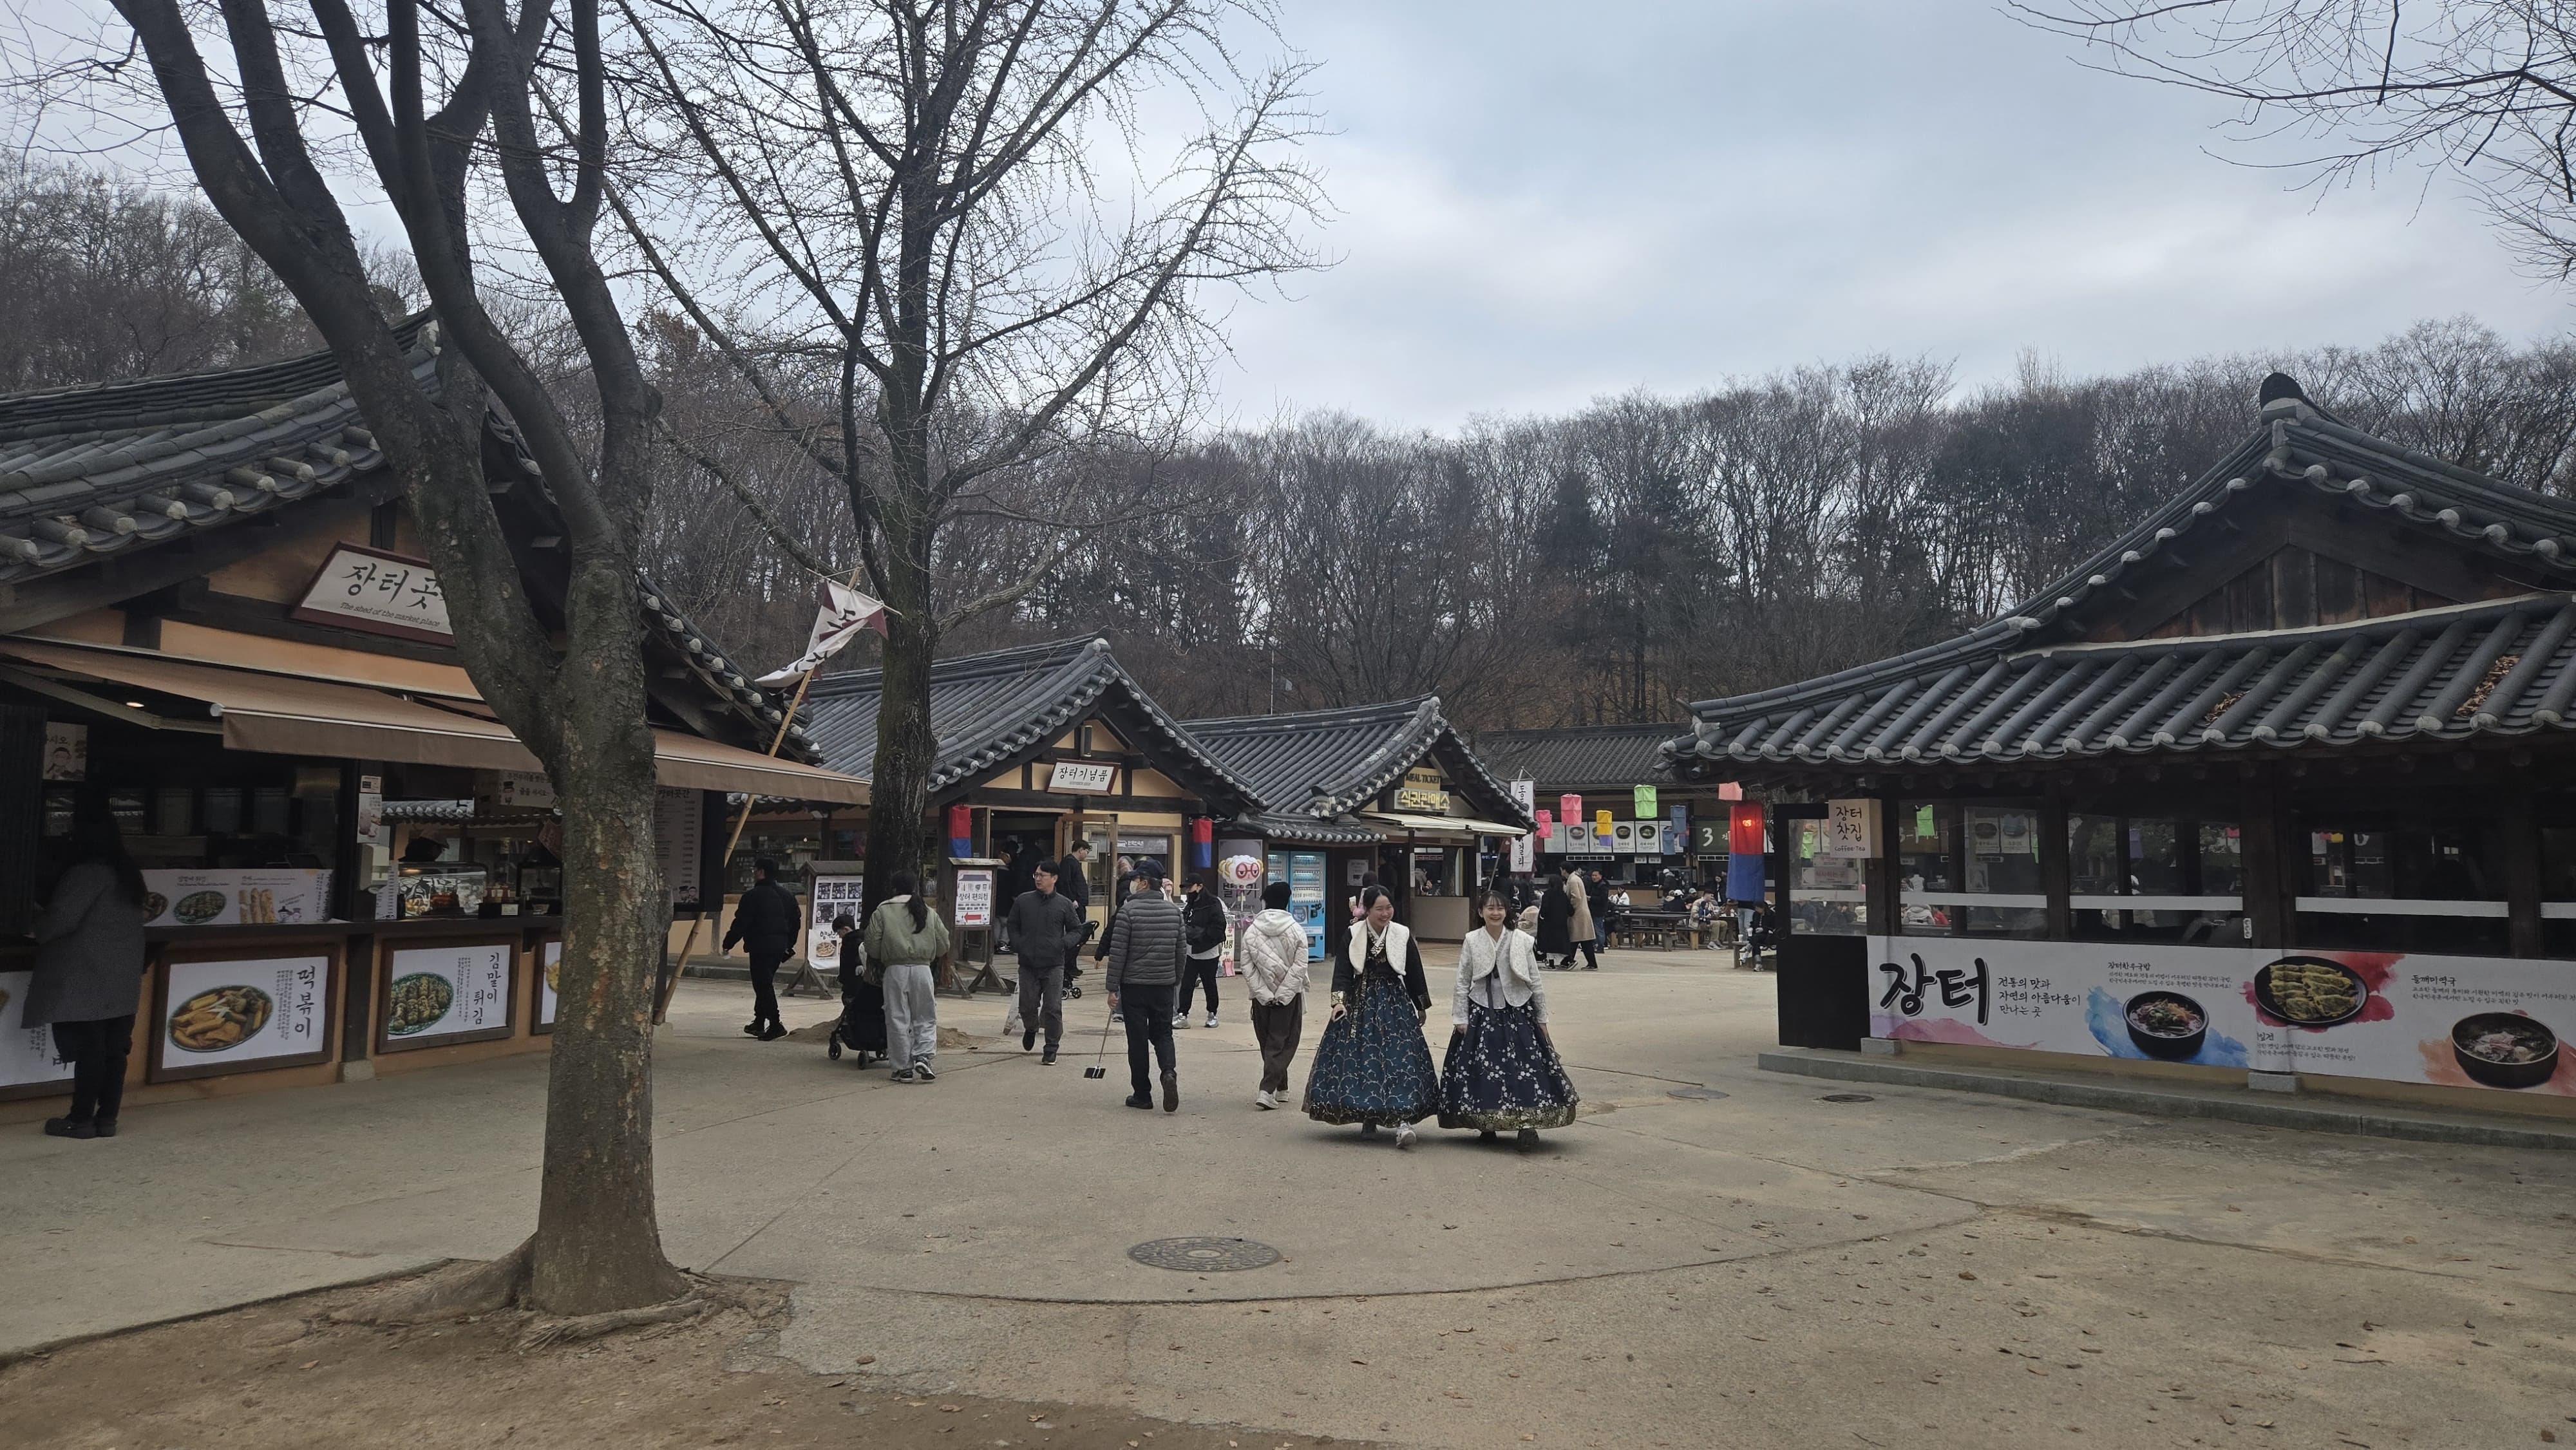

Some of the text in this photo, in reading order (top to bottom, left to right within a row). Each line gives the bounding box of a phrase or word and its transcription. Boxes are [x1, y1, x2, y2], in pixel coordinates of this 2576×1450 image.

[341, 562, 445, 610] 장터곳
[340, 602, 440, 628] The shed of the market place
[1059, 766, 1108, 782] 장터기념품
[1421, 774, 1441, 784] TICKET
[1400, 790, 1450, 810] 식권판매소
[1835, 805, 1862, 821] 장터
[1702, 827, 1714, 847] 3
[1836, 822, 1862, 842] 찻집
[972, 892, 989, 901] 편의점
[2108, 962, 2151, 972] 장터한우국밥
[486, 952, 502, 1005] 김말이
[1998, 976, 2051, 989] 전통의 맛과
[2411, 974, 2458, 987] 들깨미역국
[1879, 952, 1990, 1026] 장터
[294, 965, 316, 1040] 떡볶이
[472, 988, 484, 1025] 튀김
[1998, 991, 2081, 1006] 자연의 아름다움이
[2000, 1004, 2042, 1018] 만나는 곳
